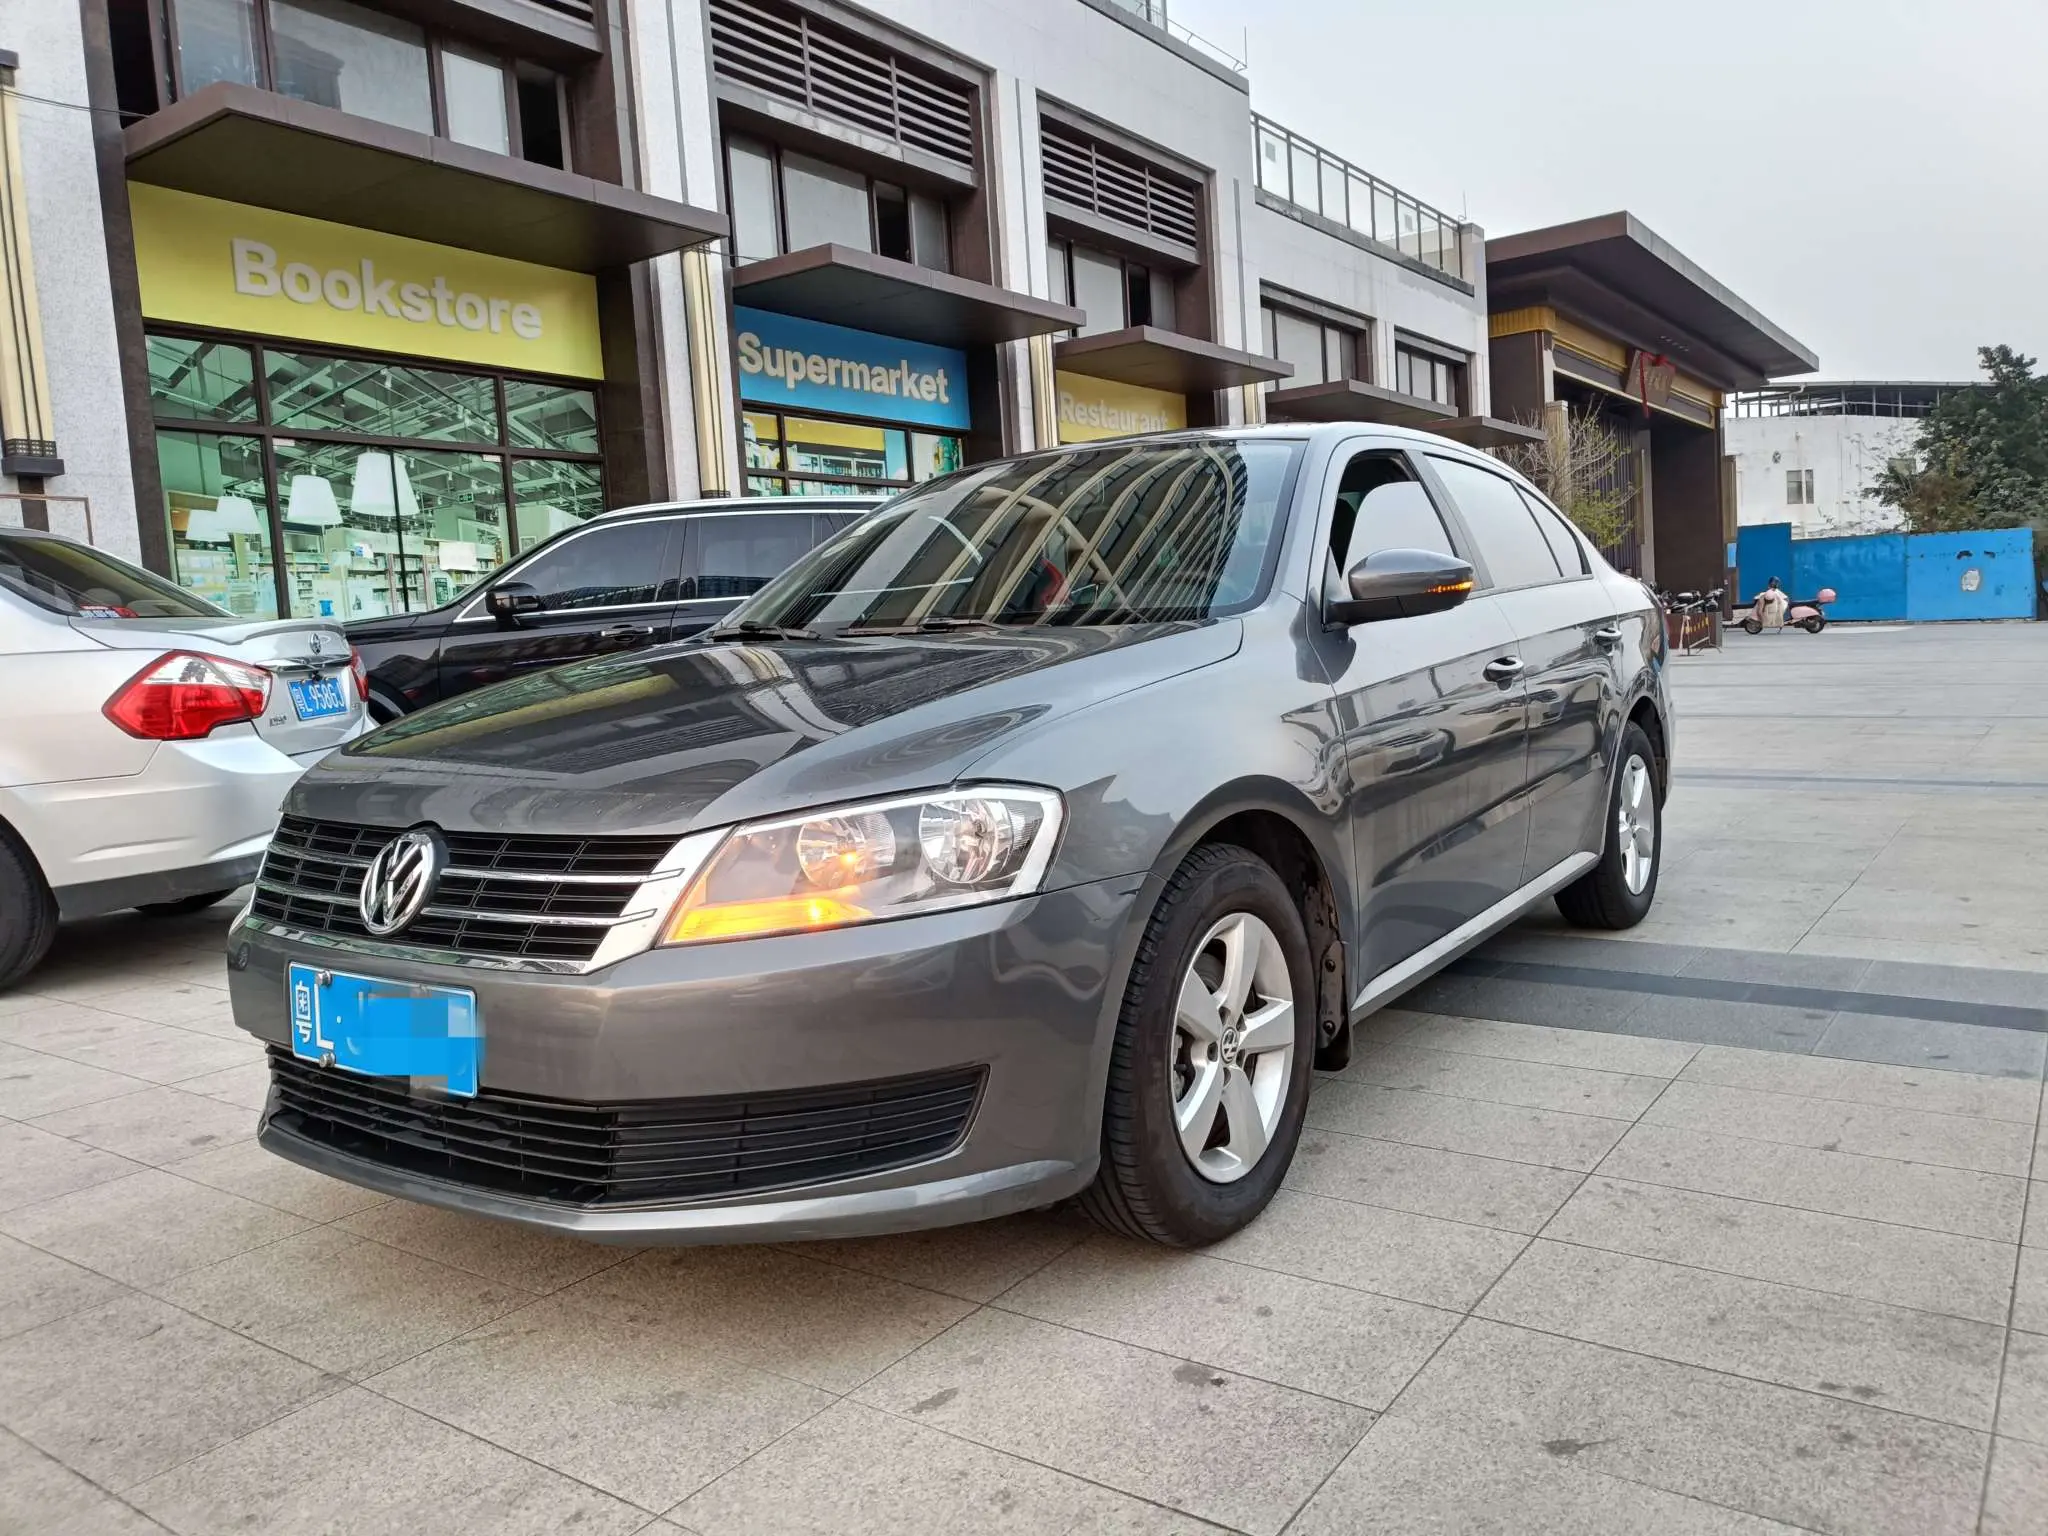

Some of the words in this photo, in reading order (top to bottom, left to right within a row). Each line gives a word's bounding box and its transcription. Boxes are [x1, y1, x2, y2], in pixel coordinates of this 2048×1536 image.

[230, 238, 543, 339] Bookstore
[737, 332, 950, 404] Supermarket
[1058, 391, 1168, 433] Restaurant
